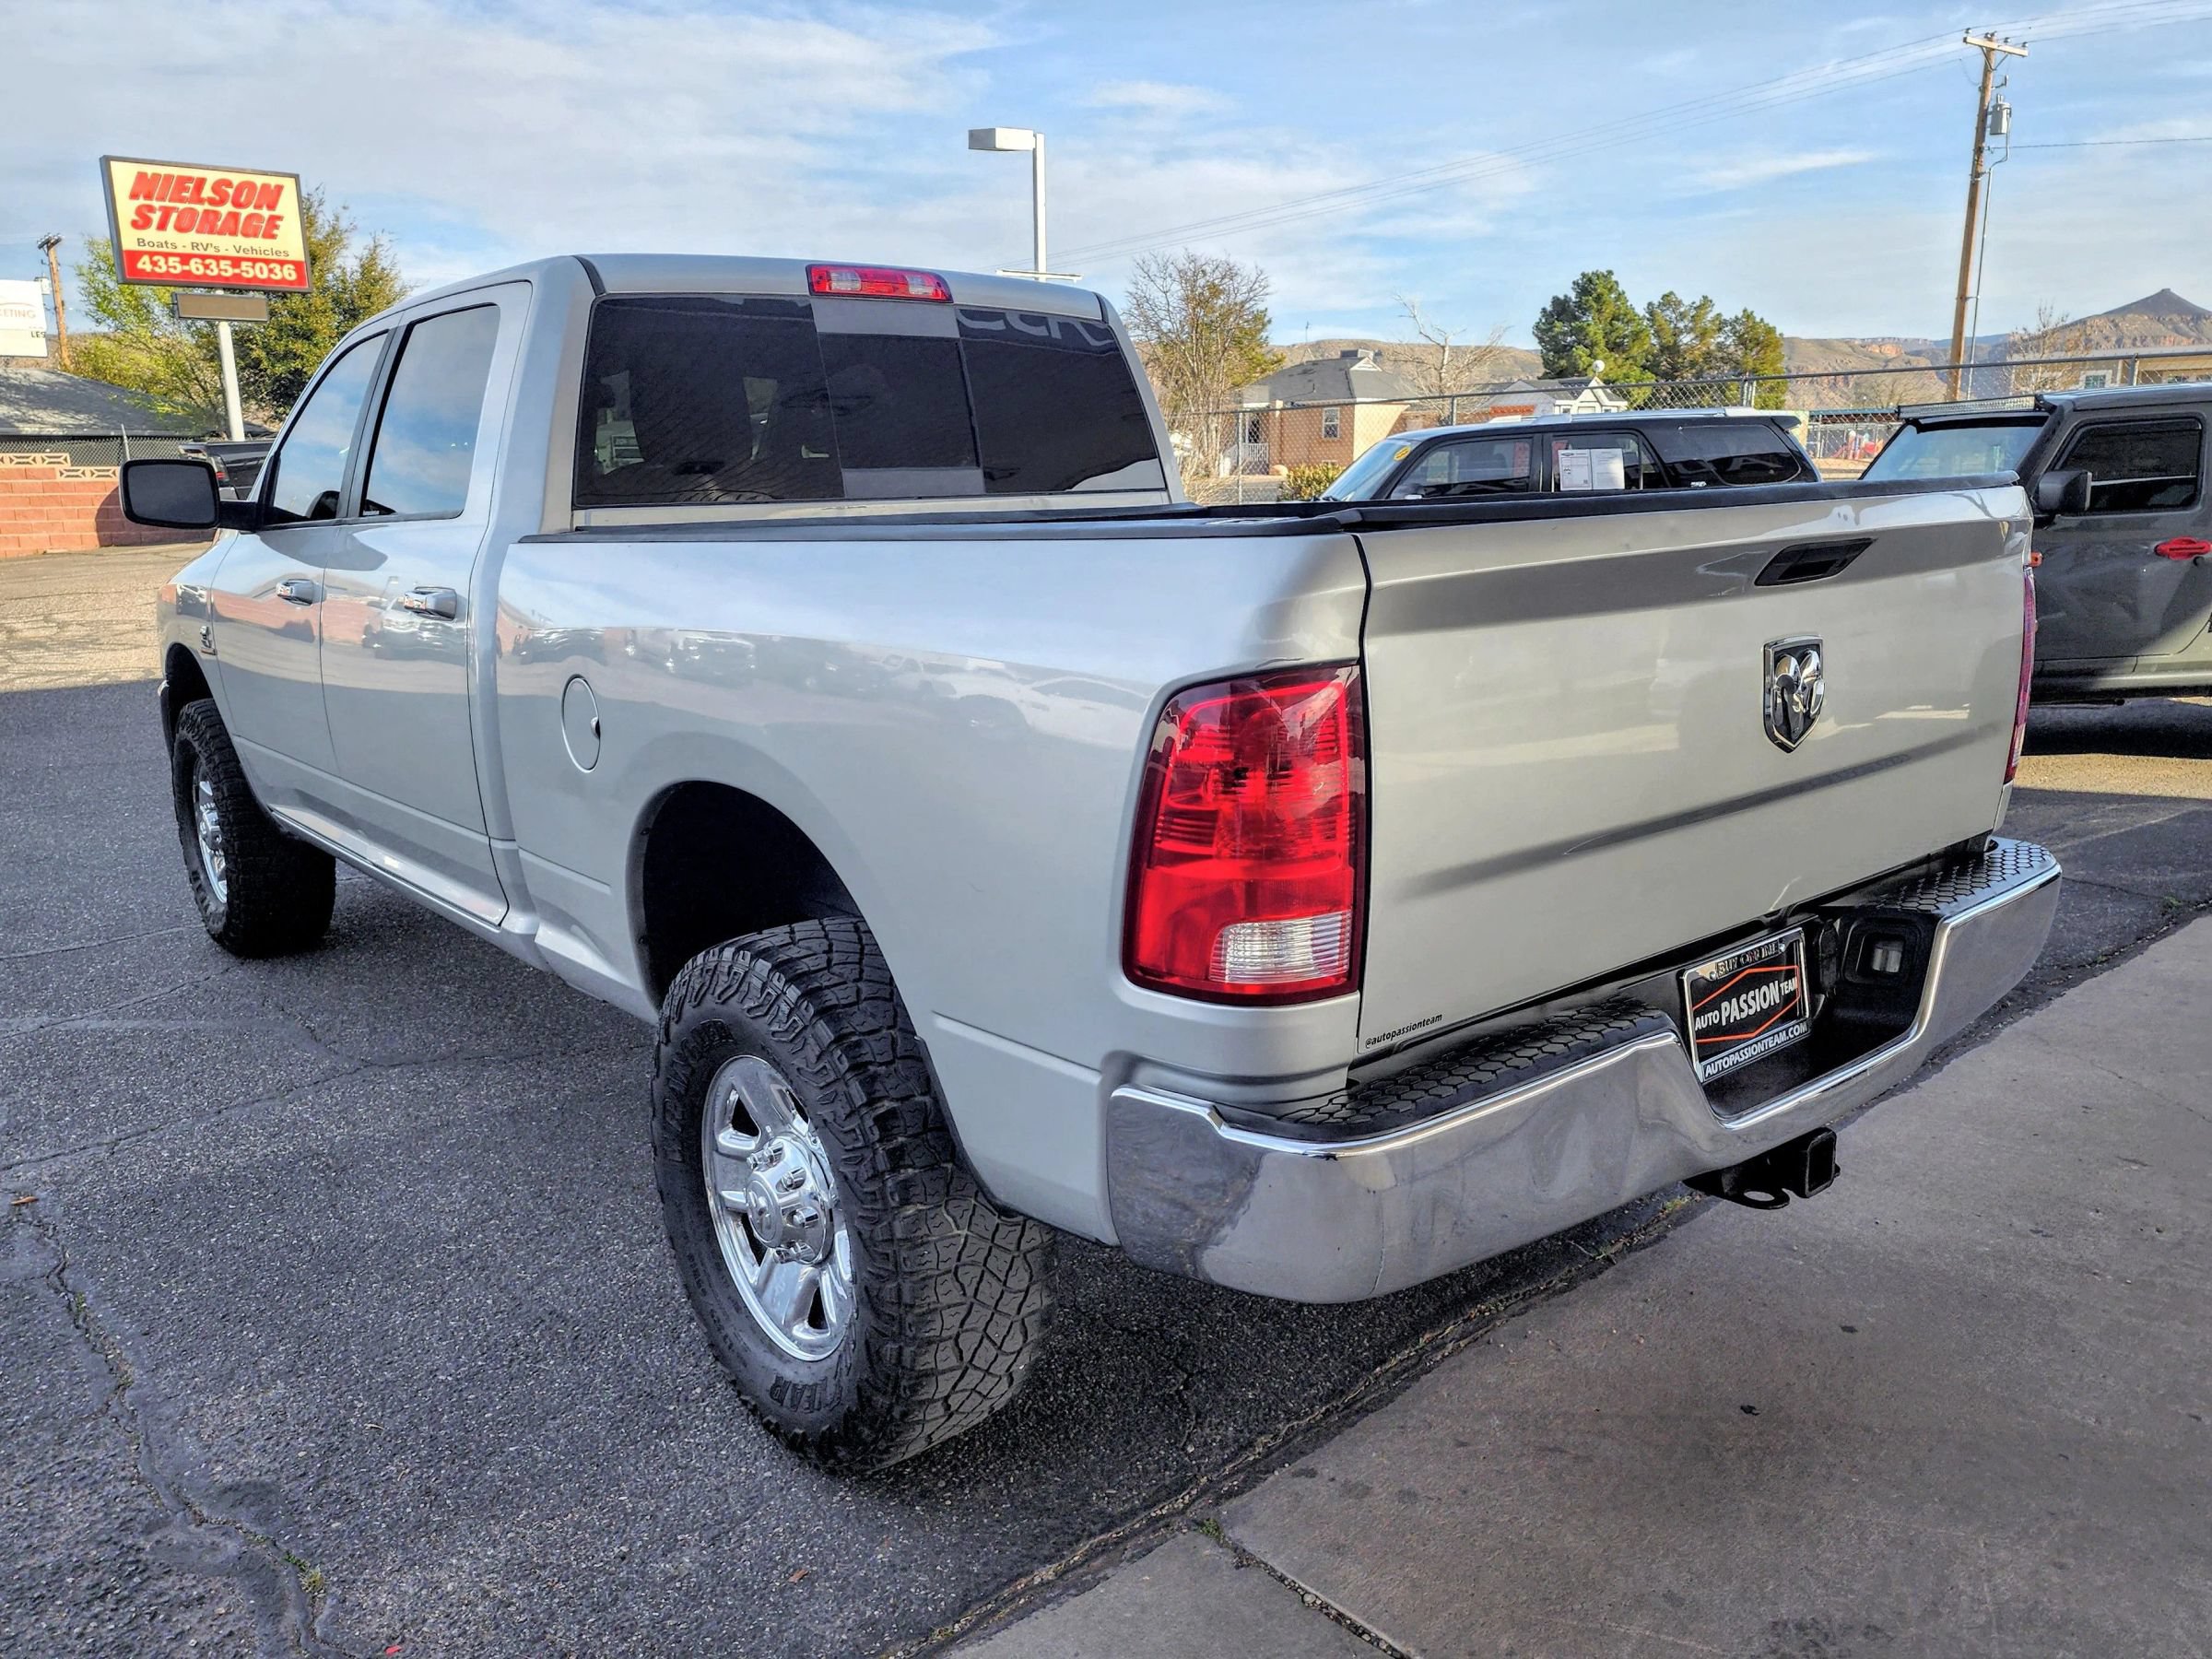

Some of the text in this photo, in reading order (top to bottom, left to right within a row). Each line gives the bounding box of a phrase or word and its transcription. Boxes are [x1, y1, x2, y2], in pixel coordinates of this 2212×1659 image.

[128, 171, 284, 211] NIELSON
[130, 204, 284, 240] STORAGE
[136, 237, 178, 250] Boats
[191, 241, 220, 253] RV's
[232, 243, 290, 257] Vehicles
[136, 254, 298, 281] 435-635-5036
[1694, 976, 1798, 1031] AUTO PASSION TEAM
[1365, 1014, 1443, 1049] @autopassionteam
[1704, 1022, 1808, 1077] AUTOPASSIONTEAM.COM
